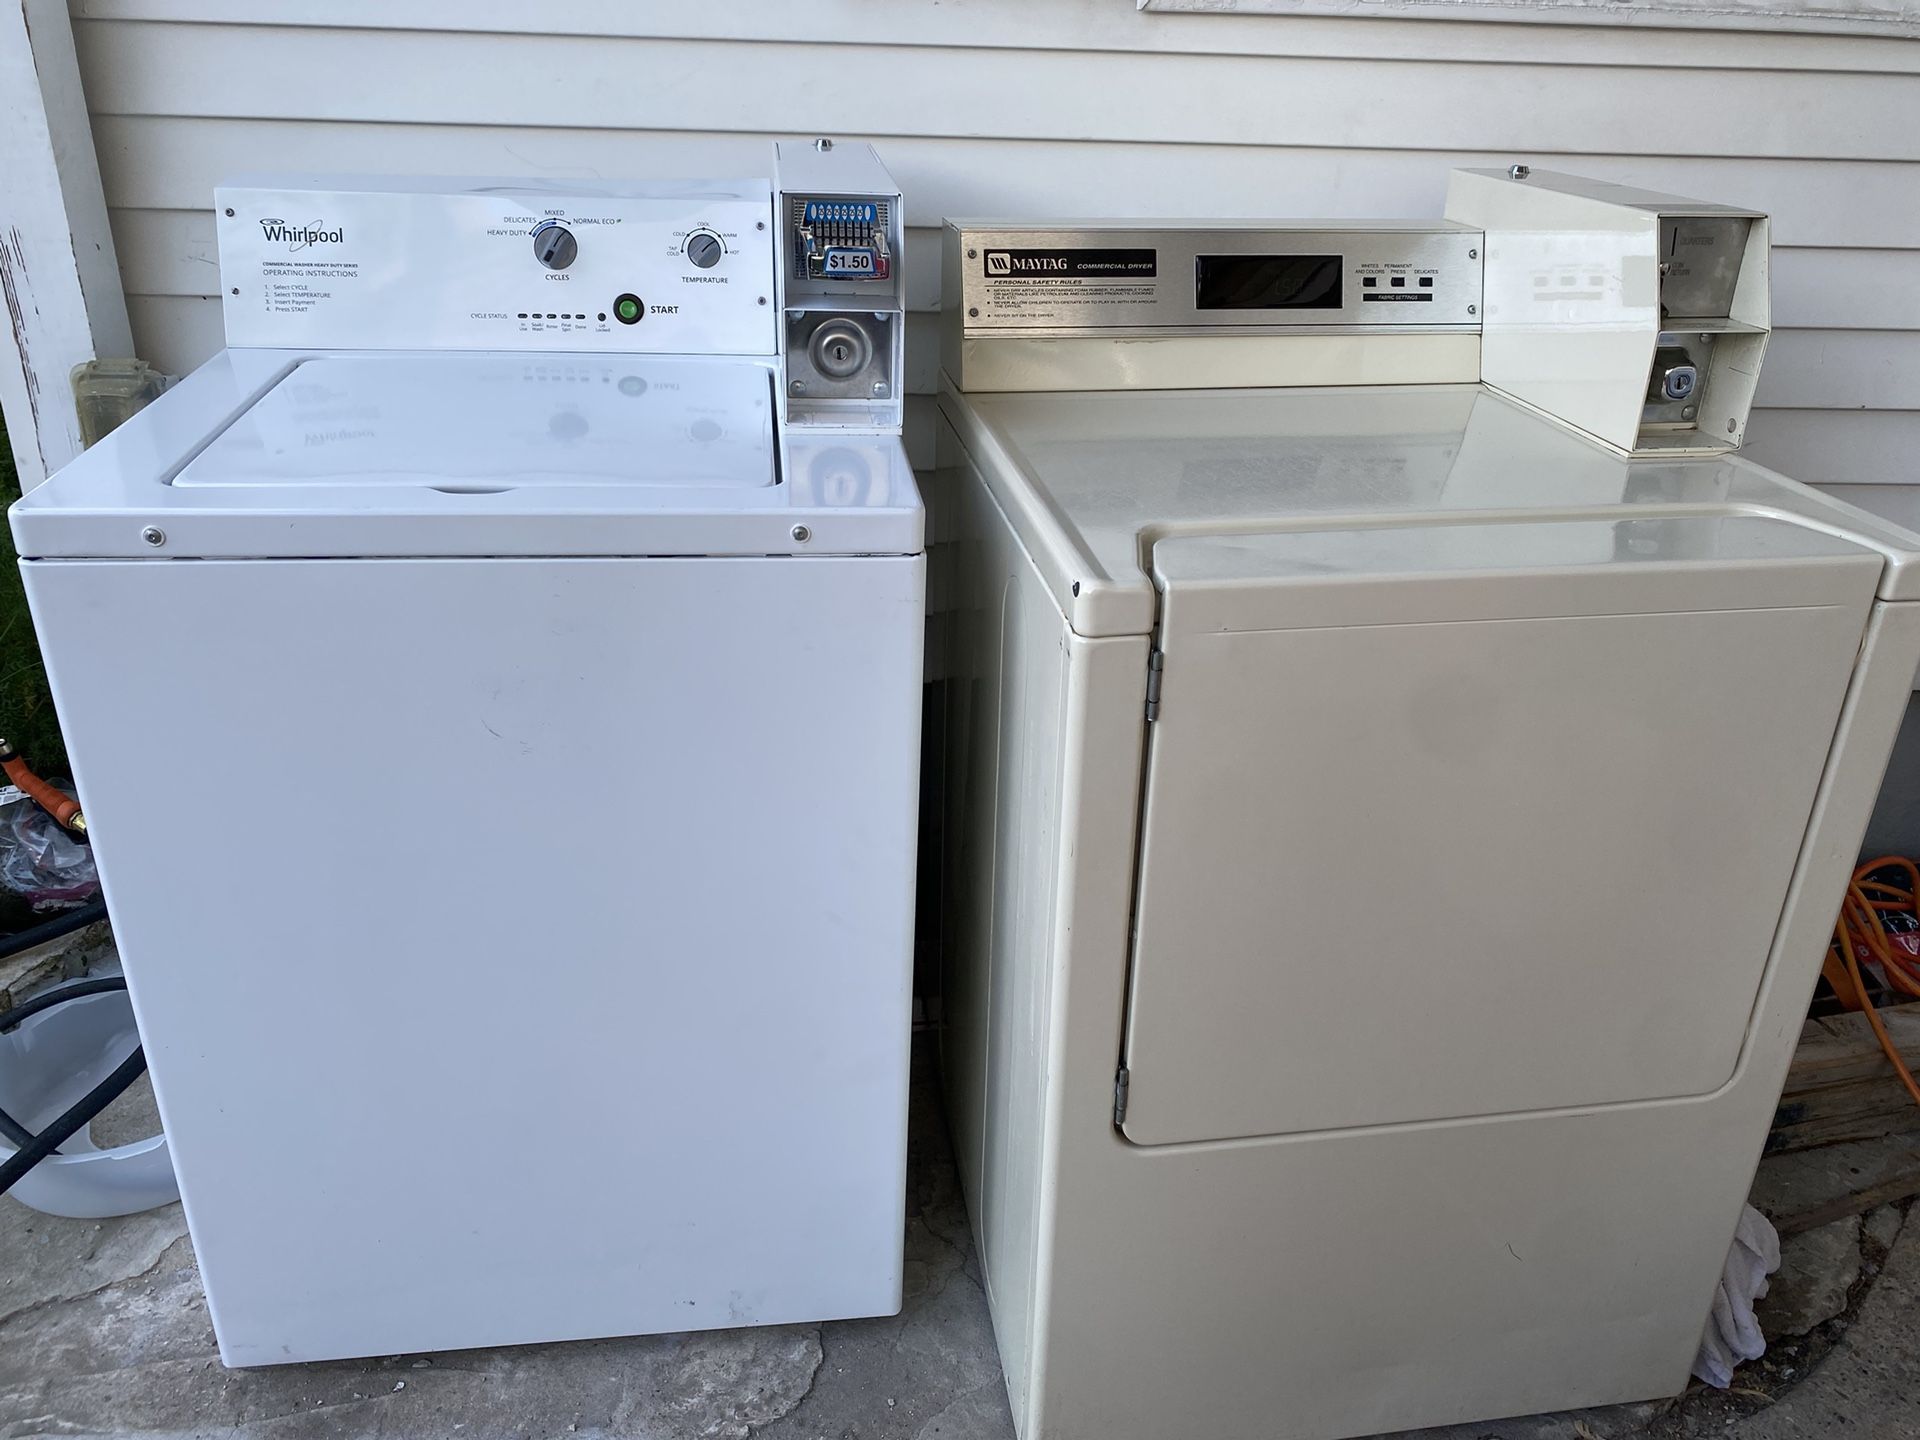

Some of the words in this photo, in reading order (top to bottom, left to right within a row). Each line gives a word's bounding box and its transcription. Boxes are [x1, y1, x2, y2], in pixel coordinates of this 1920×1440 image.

[262, 225, 344, 247] Whirlpool
[830, 254, 869, 269] $1.50
[1012, 258, 1068, 270] MAYTAG
[650, 305, 679, 314] START
